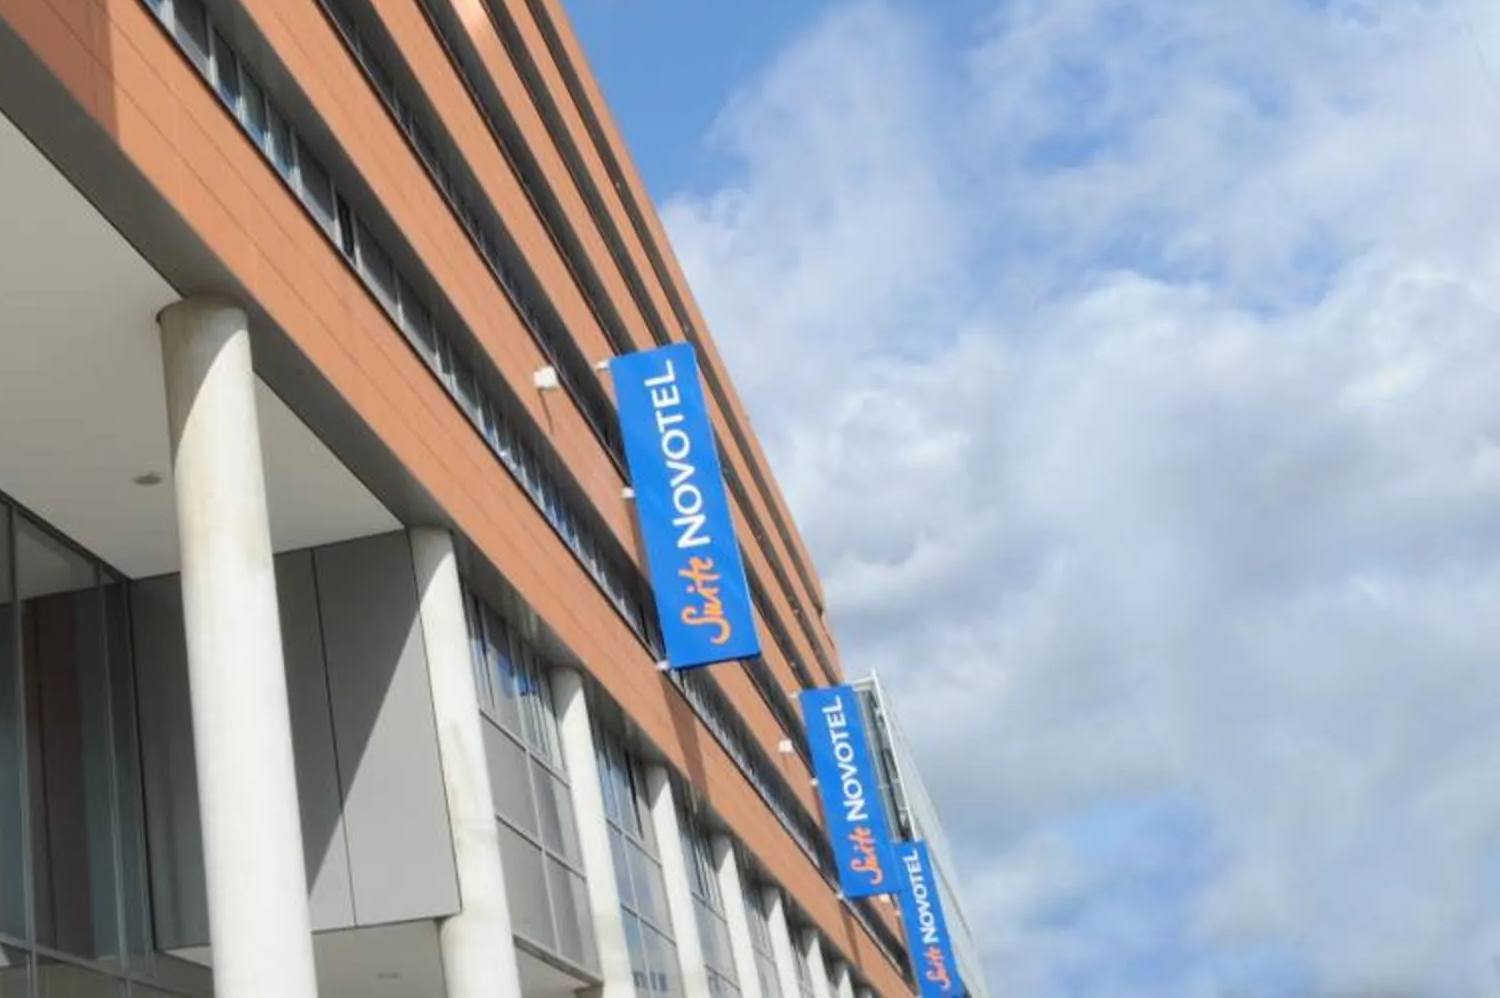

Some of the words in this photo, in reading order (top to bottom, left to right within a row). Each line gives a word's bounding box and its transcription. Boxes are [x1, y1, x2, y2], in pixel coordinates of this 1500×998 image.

[644, 359, 711, 548] NOVOTEL
[678, 556, 731, 644] Suite
[822, 695, 868, 822] NOVOTEL
[848, 826, 883, 885] Suite
[903, 848, 939, 943] NOVOTEL
